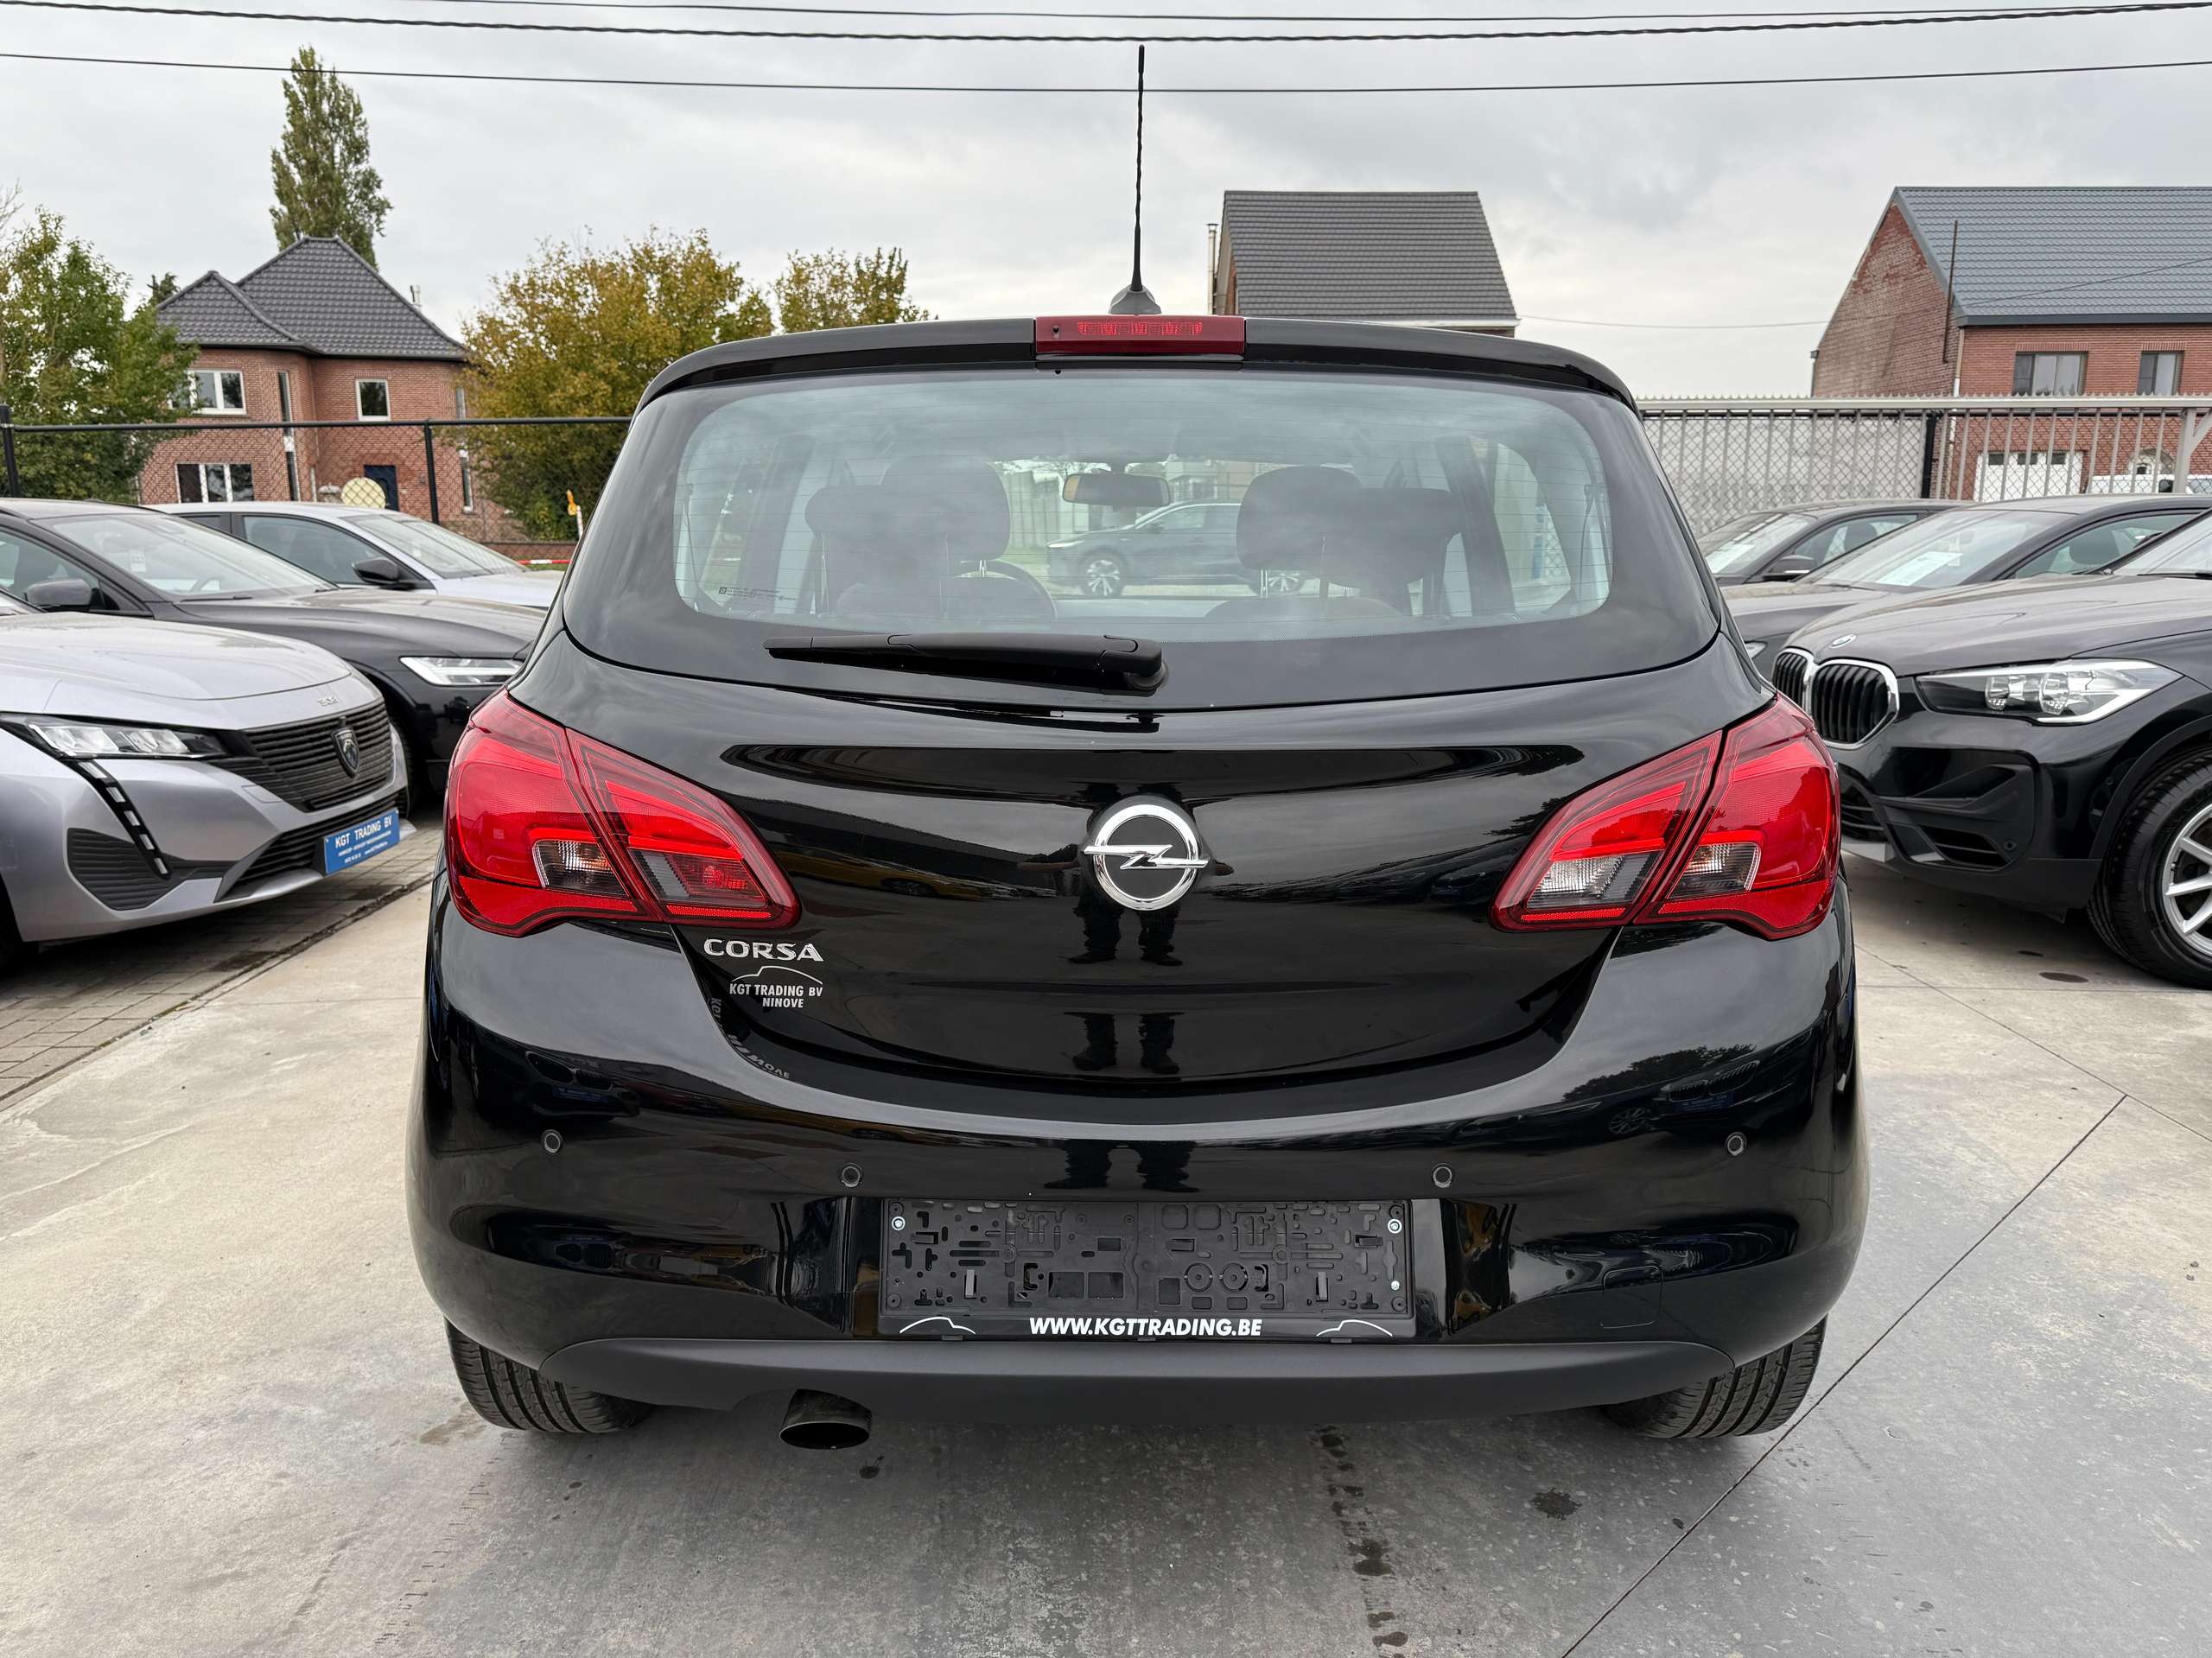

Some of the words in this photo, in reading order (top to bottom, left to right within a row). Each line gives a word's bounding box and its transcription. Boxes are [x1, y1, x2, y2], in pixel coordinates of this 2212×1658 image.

[335, 833, 350, 848] KGT
[354, 820, 381, 841] TRADING
[384, 815, 392, 828] BV
[703, 938, 824, 962] CORSA
[729, 983, 752, 995] KGT
[754, 984, 804, 997] TRADING
[808, 987, 823, 997] BV
[762, 997, 804, 1008] NINOVE
[1029, 1317, 1262, 1336] WWW.KGTTRADING.BE
